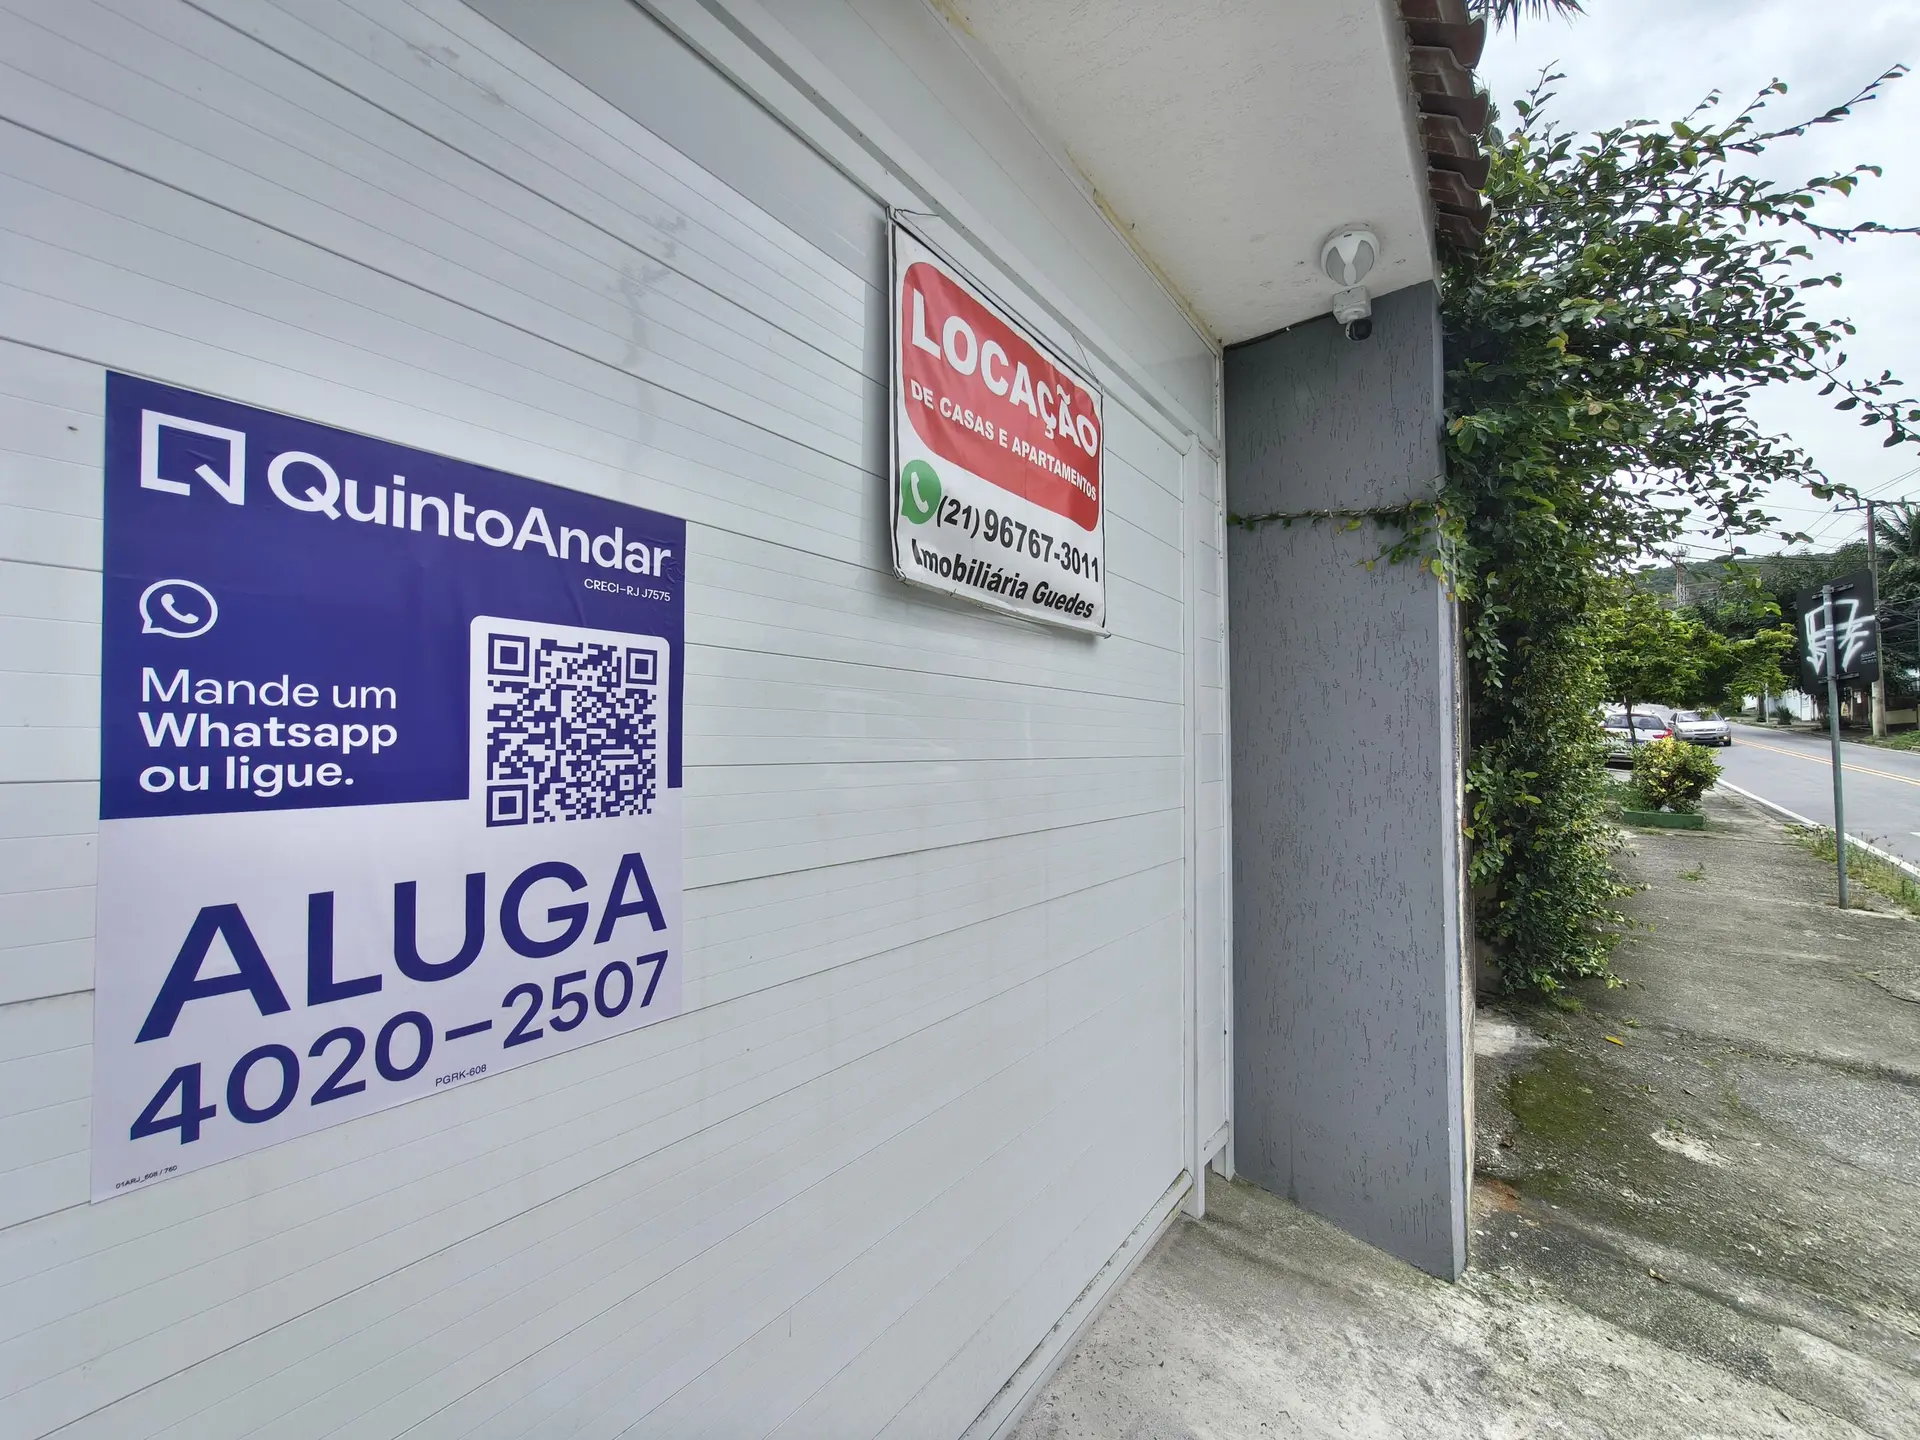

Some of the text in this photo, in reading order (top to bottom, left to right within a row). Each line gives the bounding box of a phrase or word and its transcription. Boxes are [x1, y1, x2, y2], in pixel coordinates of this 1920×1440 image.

[911, 288, 1098, 457] LOCAÇÃO
[911, 379, 1097, 502] DE CASAS E APARTAMENTOS
[267, 451, 671, 577] QuintoAndar
[641, 588, 671, 602] J7575
[1032, 581, 1095, 619] Guedes
[141, 667, 397, 709] Mande um
[139, 712, 398, 753] Whatsapp
[139, 756, 354, 797] ou ligue.
[134, 853, 667, 1044] ALUGA
[130, 950, 668, 1145] 4020-2507
[435, 1063, 487, 1087] PGRK-608
